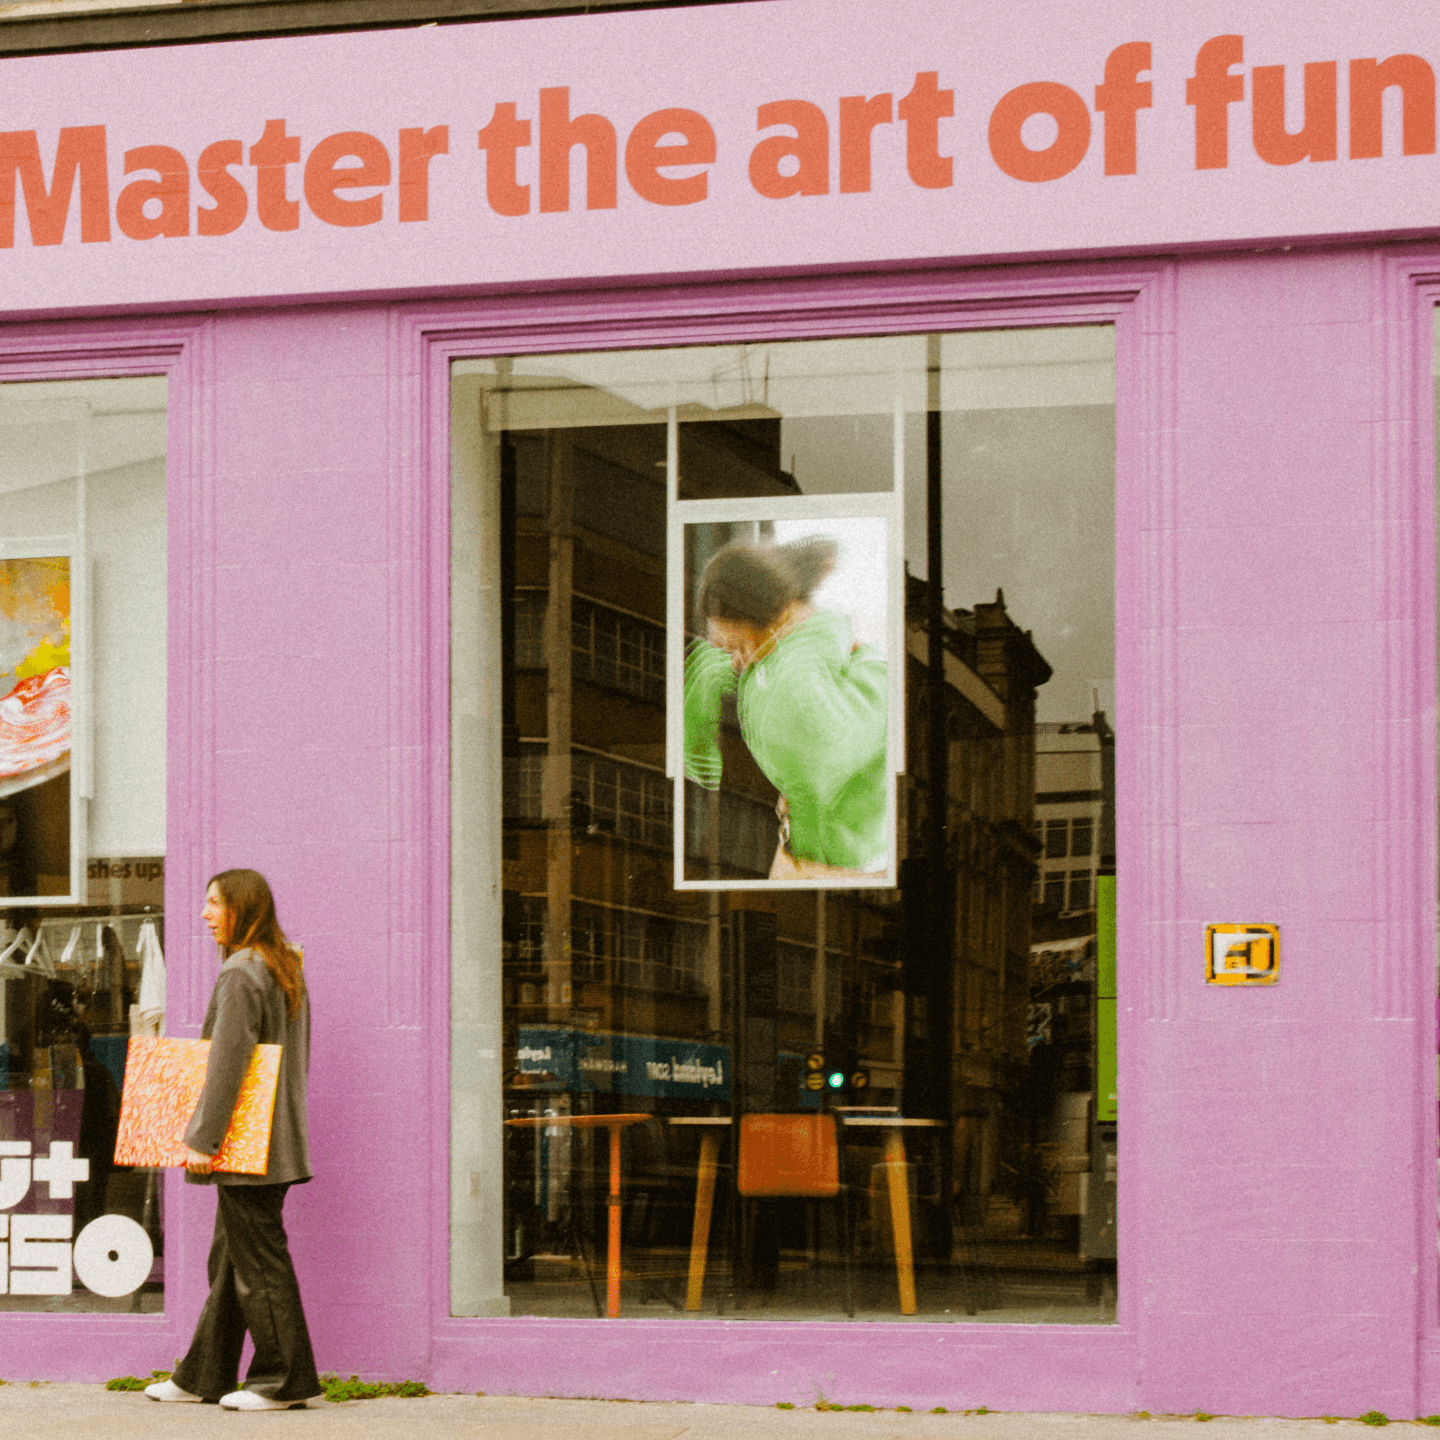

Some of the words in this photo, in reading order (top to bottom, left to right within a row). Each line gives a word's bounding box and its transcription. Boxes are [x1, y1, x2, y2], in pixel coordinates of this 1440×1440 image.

[479, 87, 716, 216] the
[749, 71, 954, 199] art
[988, 41, 1152, 183] of
[1186, 34, 1436, 170] fun
